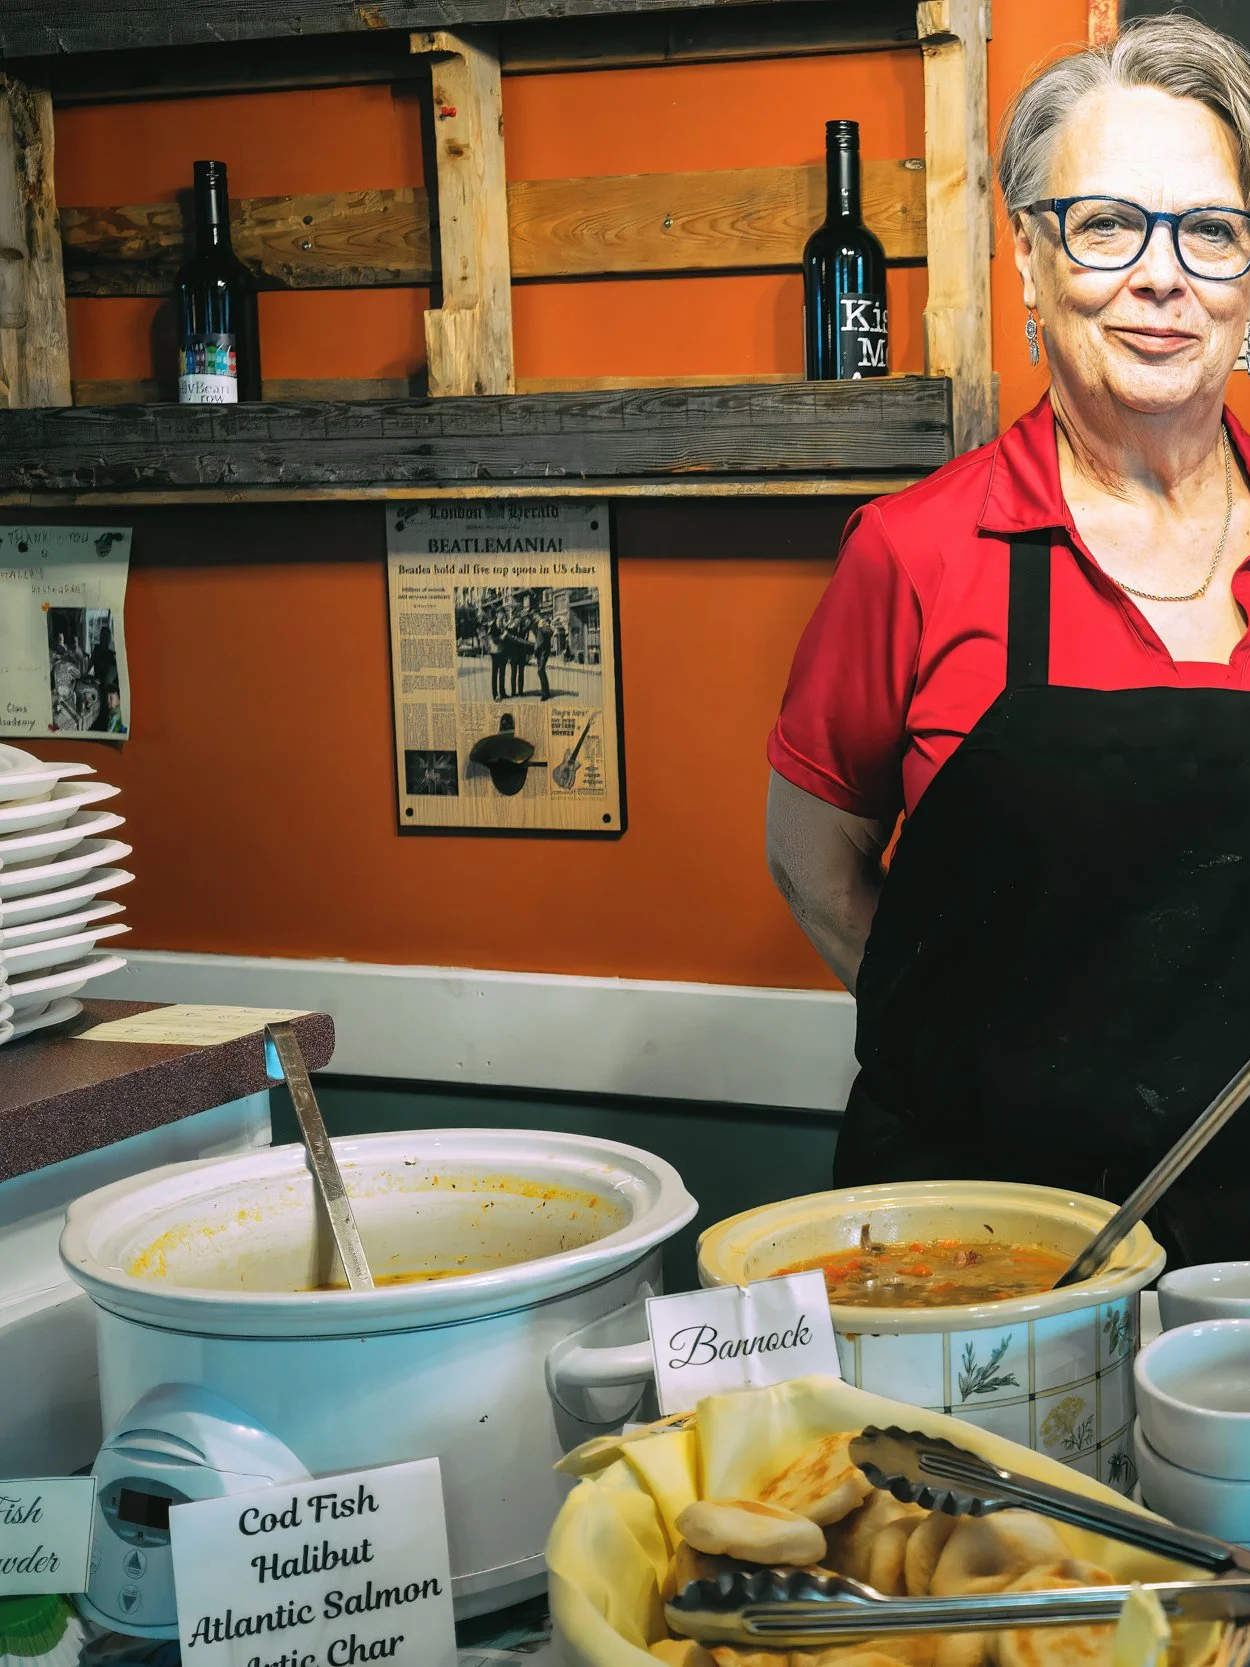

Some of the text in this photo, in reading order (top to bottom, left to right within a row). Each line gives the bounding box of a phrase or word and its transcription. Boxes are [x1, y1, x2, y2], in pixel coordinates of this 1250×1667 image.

[857, 337, 888, 367] M
[428, 503, 559, 520] London Herald
[428, 537, 563, 553] BEATLEMANIA!
[398, 563, 596, 577] Beatles hold all five top spots in US chart
[669, 1315, 813, 1369] Bannock
[239, 1485, 379, 1536] Cod Fish
[251, 1538, 375, 1583] Halibut
[188, 1577, 443, 1648] Atlantic Salmon
[327, 1633, 405, 1667] Char
